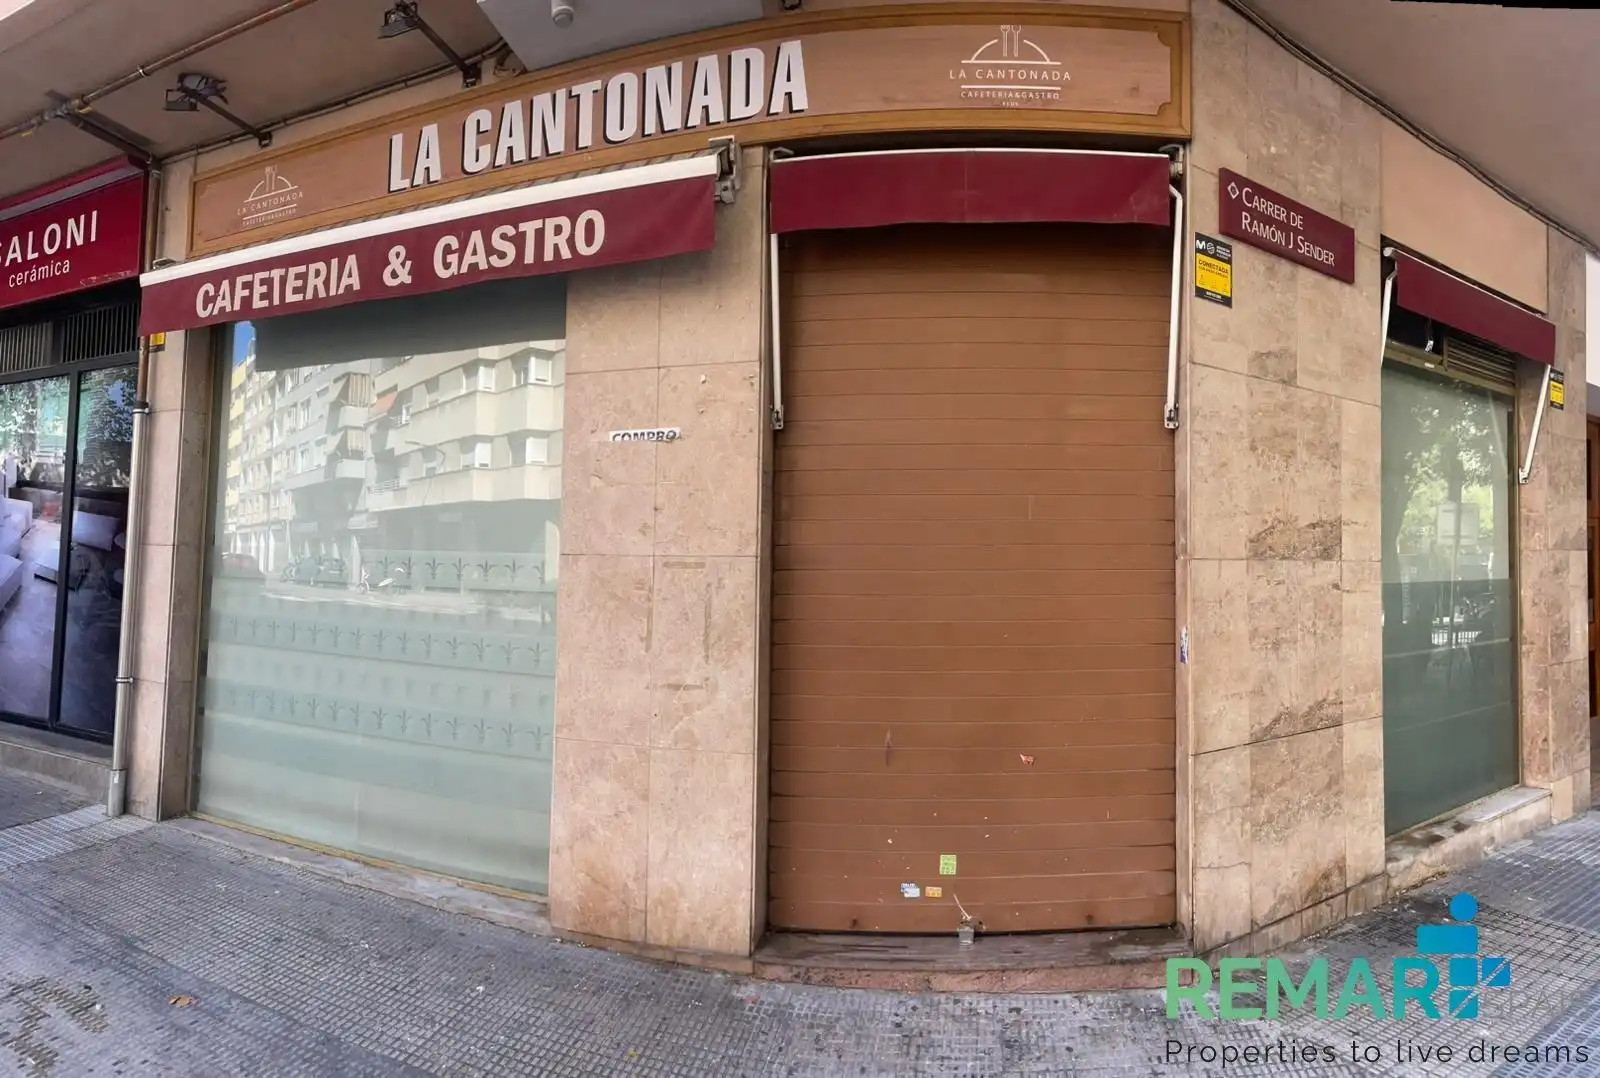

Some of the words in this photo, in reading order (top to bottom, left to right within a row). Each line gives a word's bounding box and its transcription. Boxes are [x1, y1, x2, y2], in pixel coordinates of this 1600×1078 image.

[949, 69, 967, 79] LA
[975, 69, 1071, 81] CANTONADA
[388, 123, 442, 192] LA
[462, 40, 808, 174] CANTONADA
[1242, 187, 1287, 223] CARRER
[1290, 211, 1304, 230] DE
[0, 209, 98, 267] ALONI
[196, 254, 361, 318] CAFETERIA
[382, 244, 412, 287] &
[433, 209, 606, 279] GASTRO
[1241, 211, 1286, 246] RAMÓN
[1288, 231, 1294, 249] J
[1297, 235, 1335, 266] SENDER
[9, 259, 70, 288] cerámica
